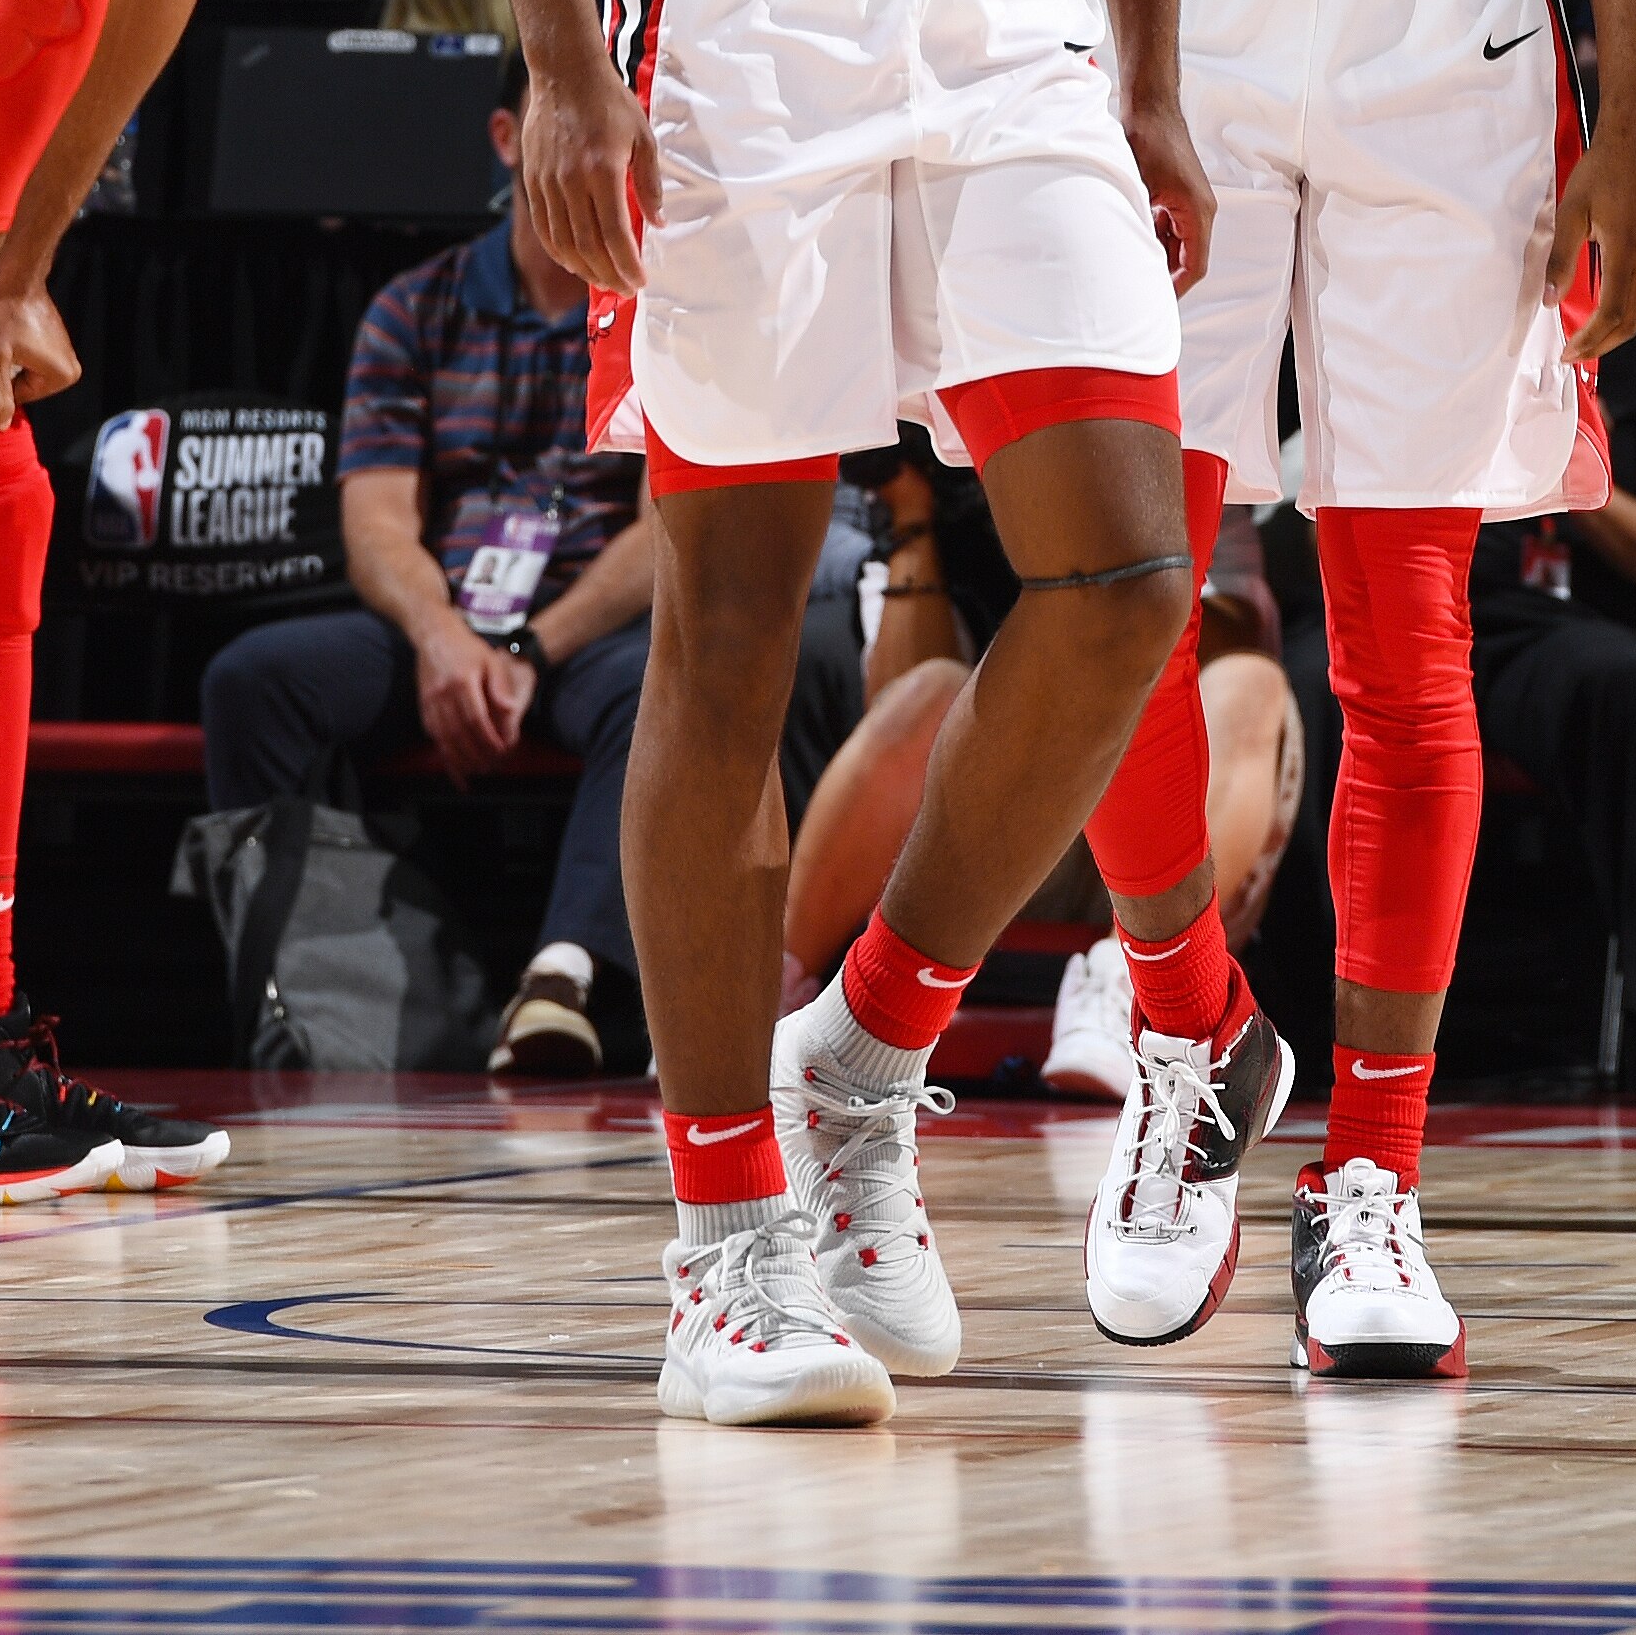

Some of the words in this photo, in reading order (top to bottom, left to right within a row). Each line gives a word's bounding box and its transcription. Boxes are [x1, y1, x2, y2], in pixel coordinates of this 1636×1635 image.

[234, 407, 328, 432] RESORTS
[173, 431, 326, 490] SUMMER
[169, 483, 298, 548] LEAGUE
